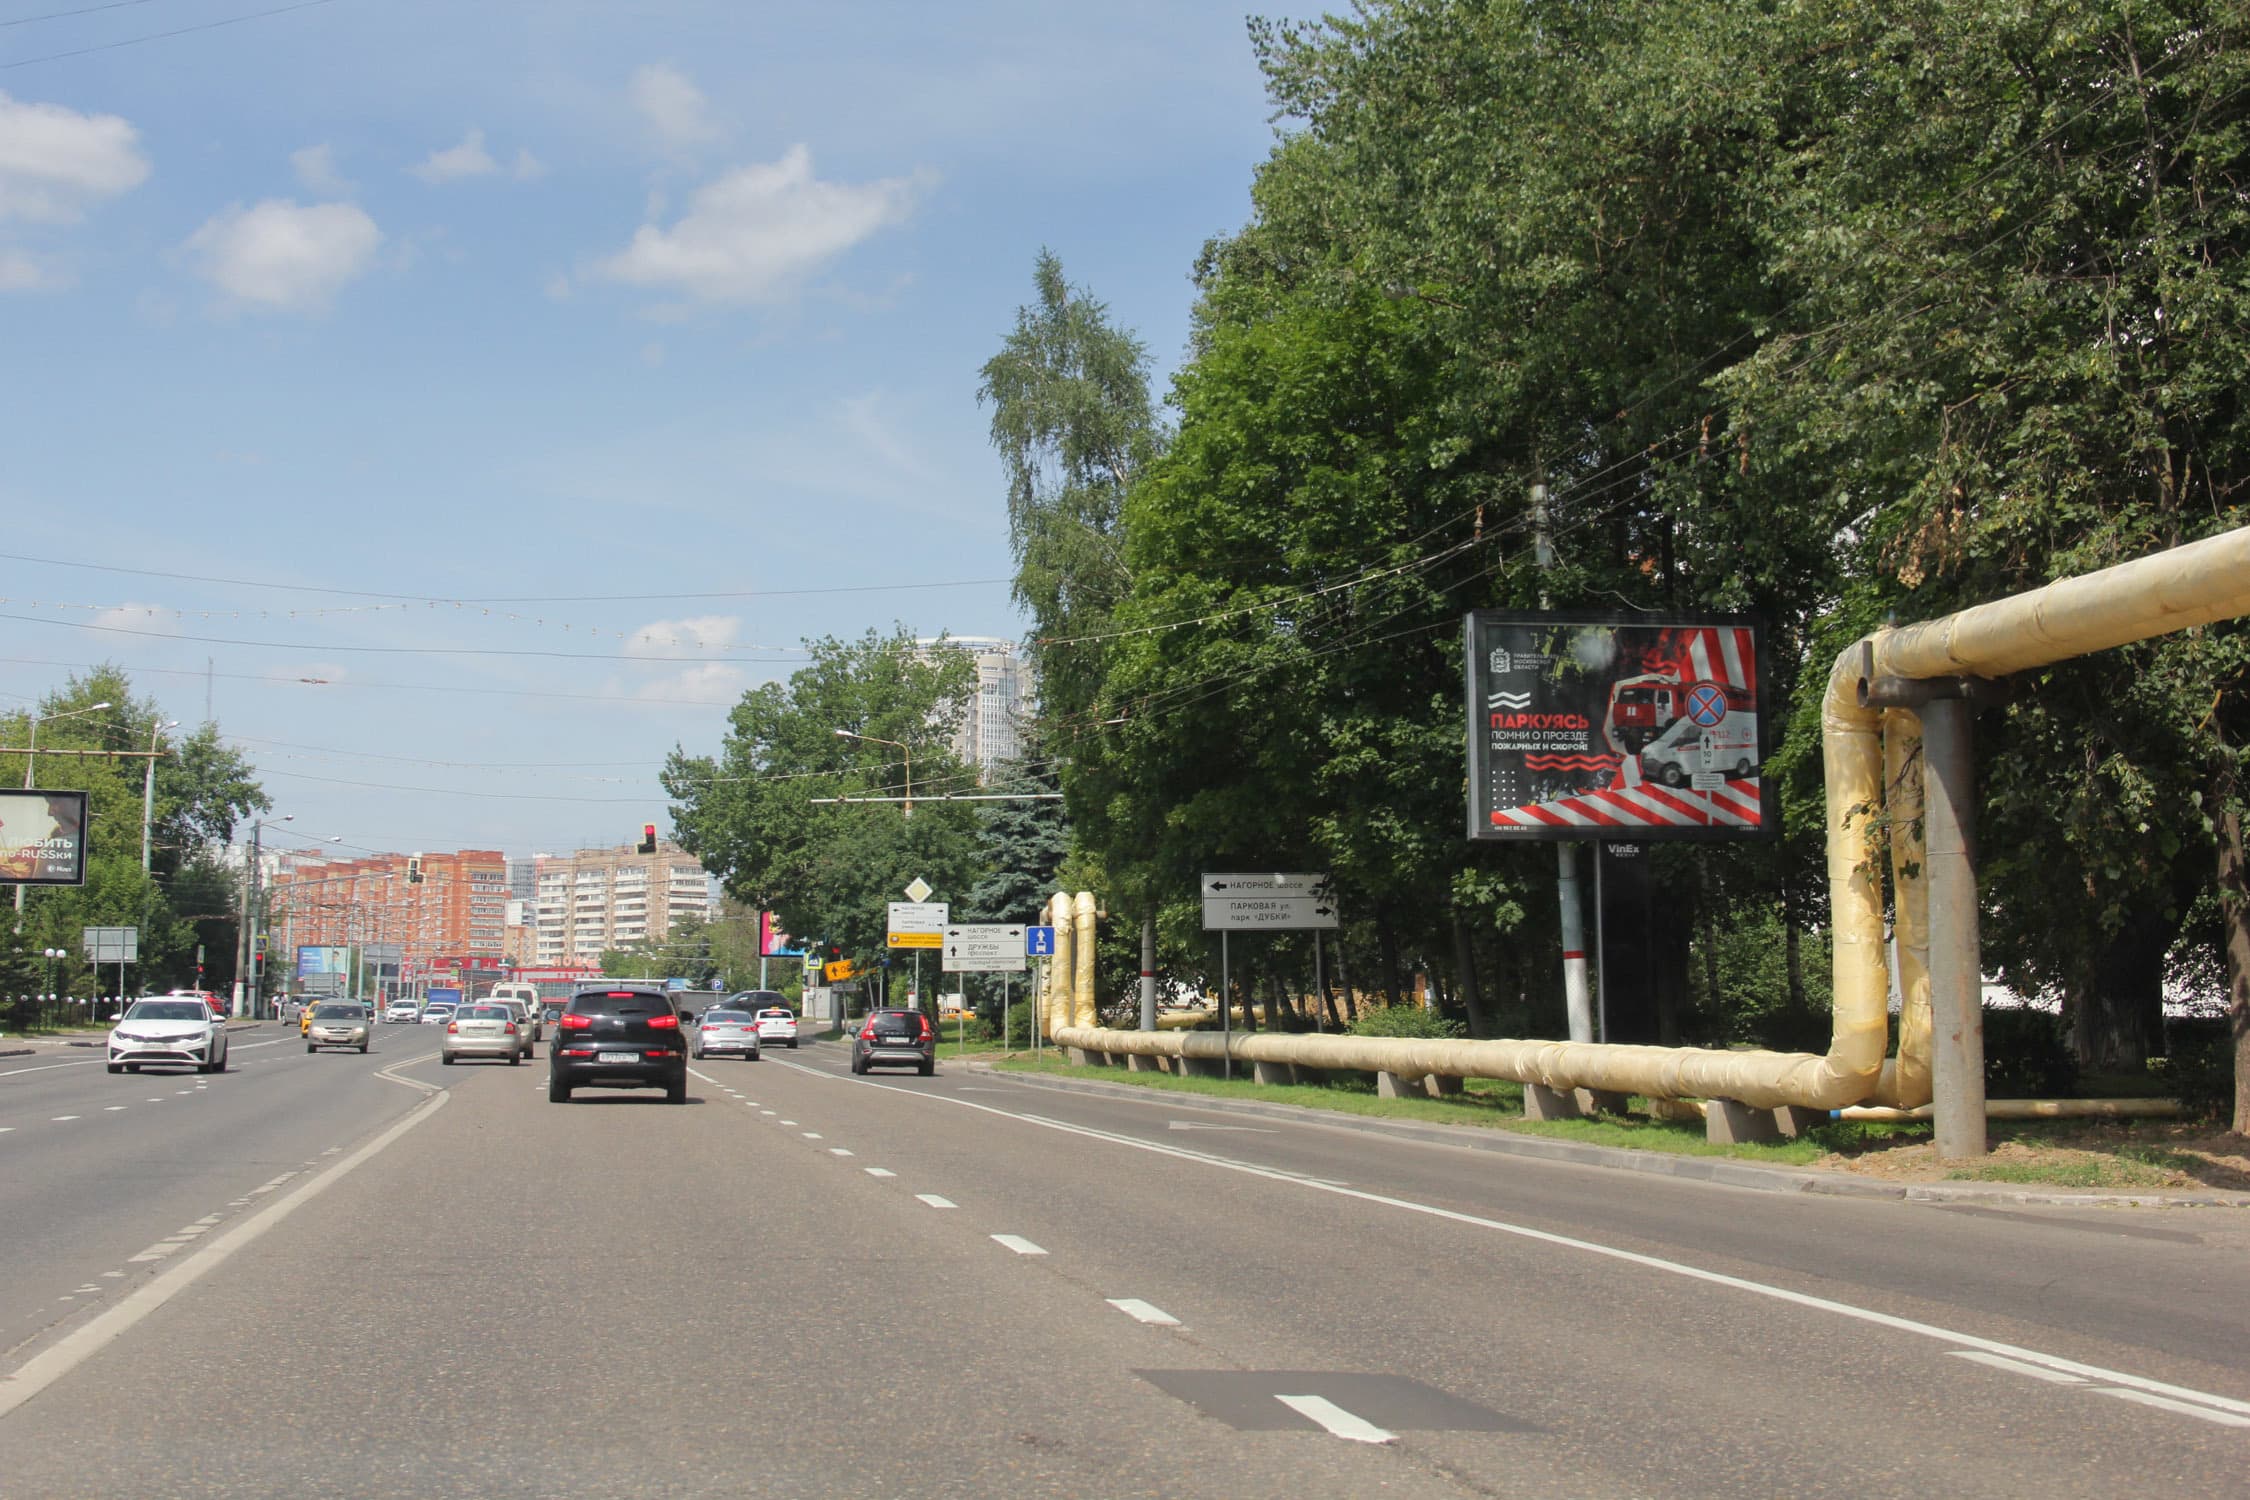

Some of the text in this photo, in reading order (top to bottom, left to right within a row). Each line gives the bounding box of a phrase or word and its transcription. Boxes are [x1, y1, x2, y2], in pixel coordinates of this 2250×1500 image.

[1490, 713, 1590, 729] ПАРКУЯСЬ
[1491, 731, 1589, 741] ПОМНИ О ПРОЕЗДЕ
[1491, 743, 1541, 751] ПОЖАРНЫХ
[1550, 742, 1588, 751] СКОРОЙ!
[1607, 844, 1640, 853] VinEx
[0, 849, 72, 860] по-RUSSки
[1230, 881, 1274, 889] НАГОРНОЕ
[1230, 902, 1277, 910] ПАРКОВАЯ
[1230, 912, 1291, 923] парк «ДУБКИ»
